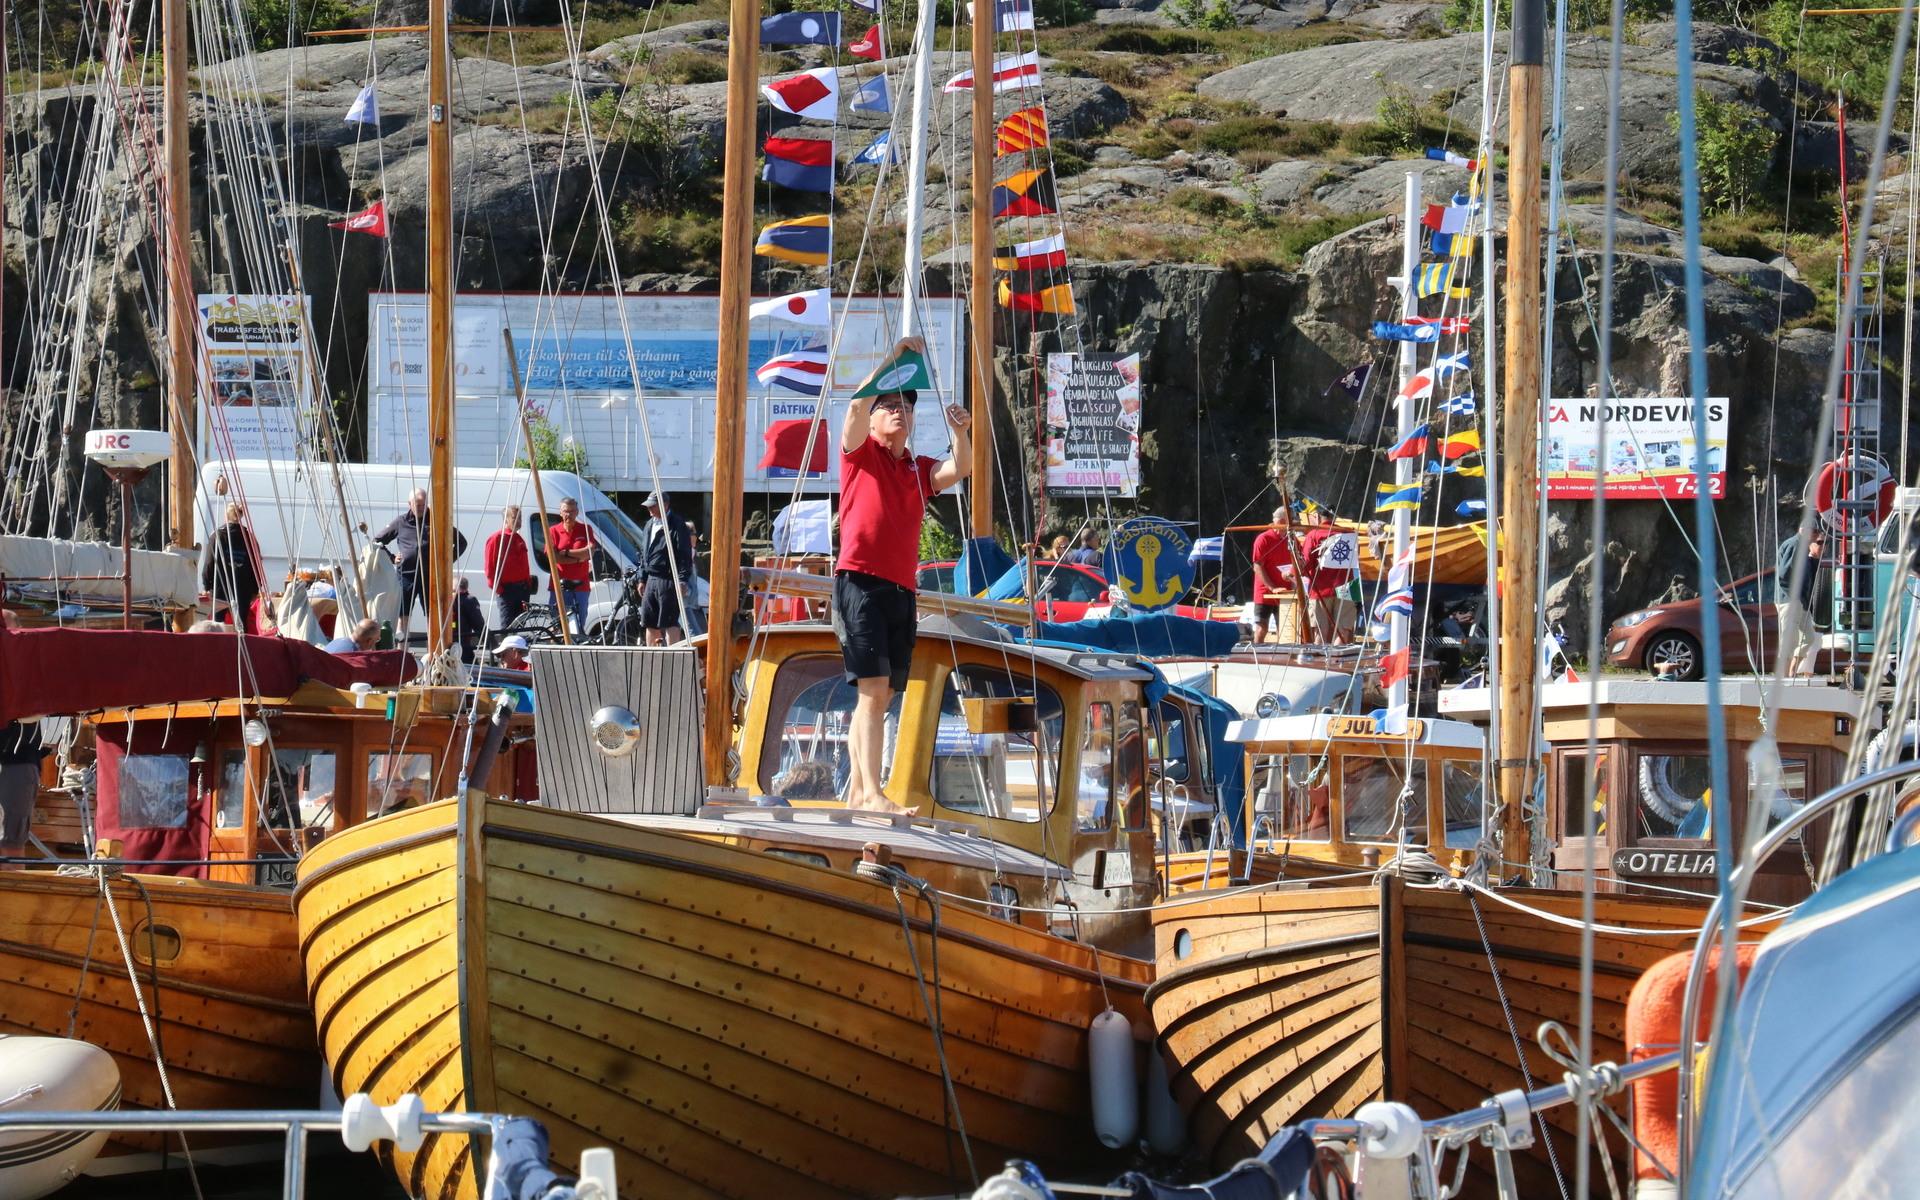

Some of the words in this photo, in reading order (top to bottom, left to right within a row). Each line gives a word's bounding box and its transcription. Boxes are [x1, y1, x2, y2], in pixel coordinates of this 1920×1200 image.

[519, 349, 590, 361] Vkommen
[575, 366, 592, 377] det
[597, 366, 628, 377] alltid
[636, 367, 665, 381] ågot
[670, 367, 684, 381] på
[773, 403, 815, 415] BÅTFIKA
[1068, 403, 1117, 413] GLASSCUP
[1580, 405, 1723, 422] NORDEVIS
[95, 435, 130, 449] JRC
[1067, 443, 1098, 454] SMOOTHIE
[1066, 471, 1121, 485] GLASSAR
[1629, 853, 1716, 874] OTELIA
